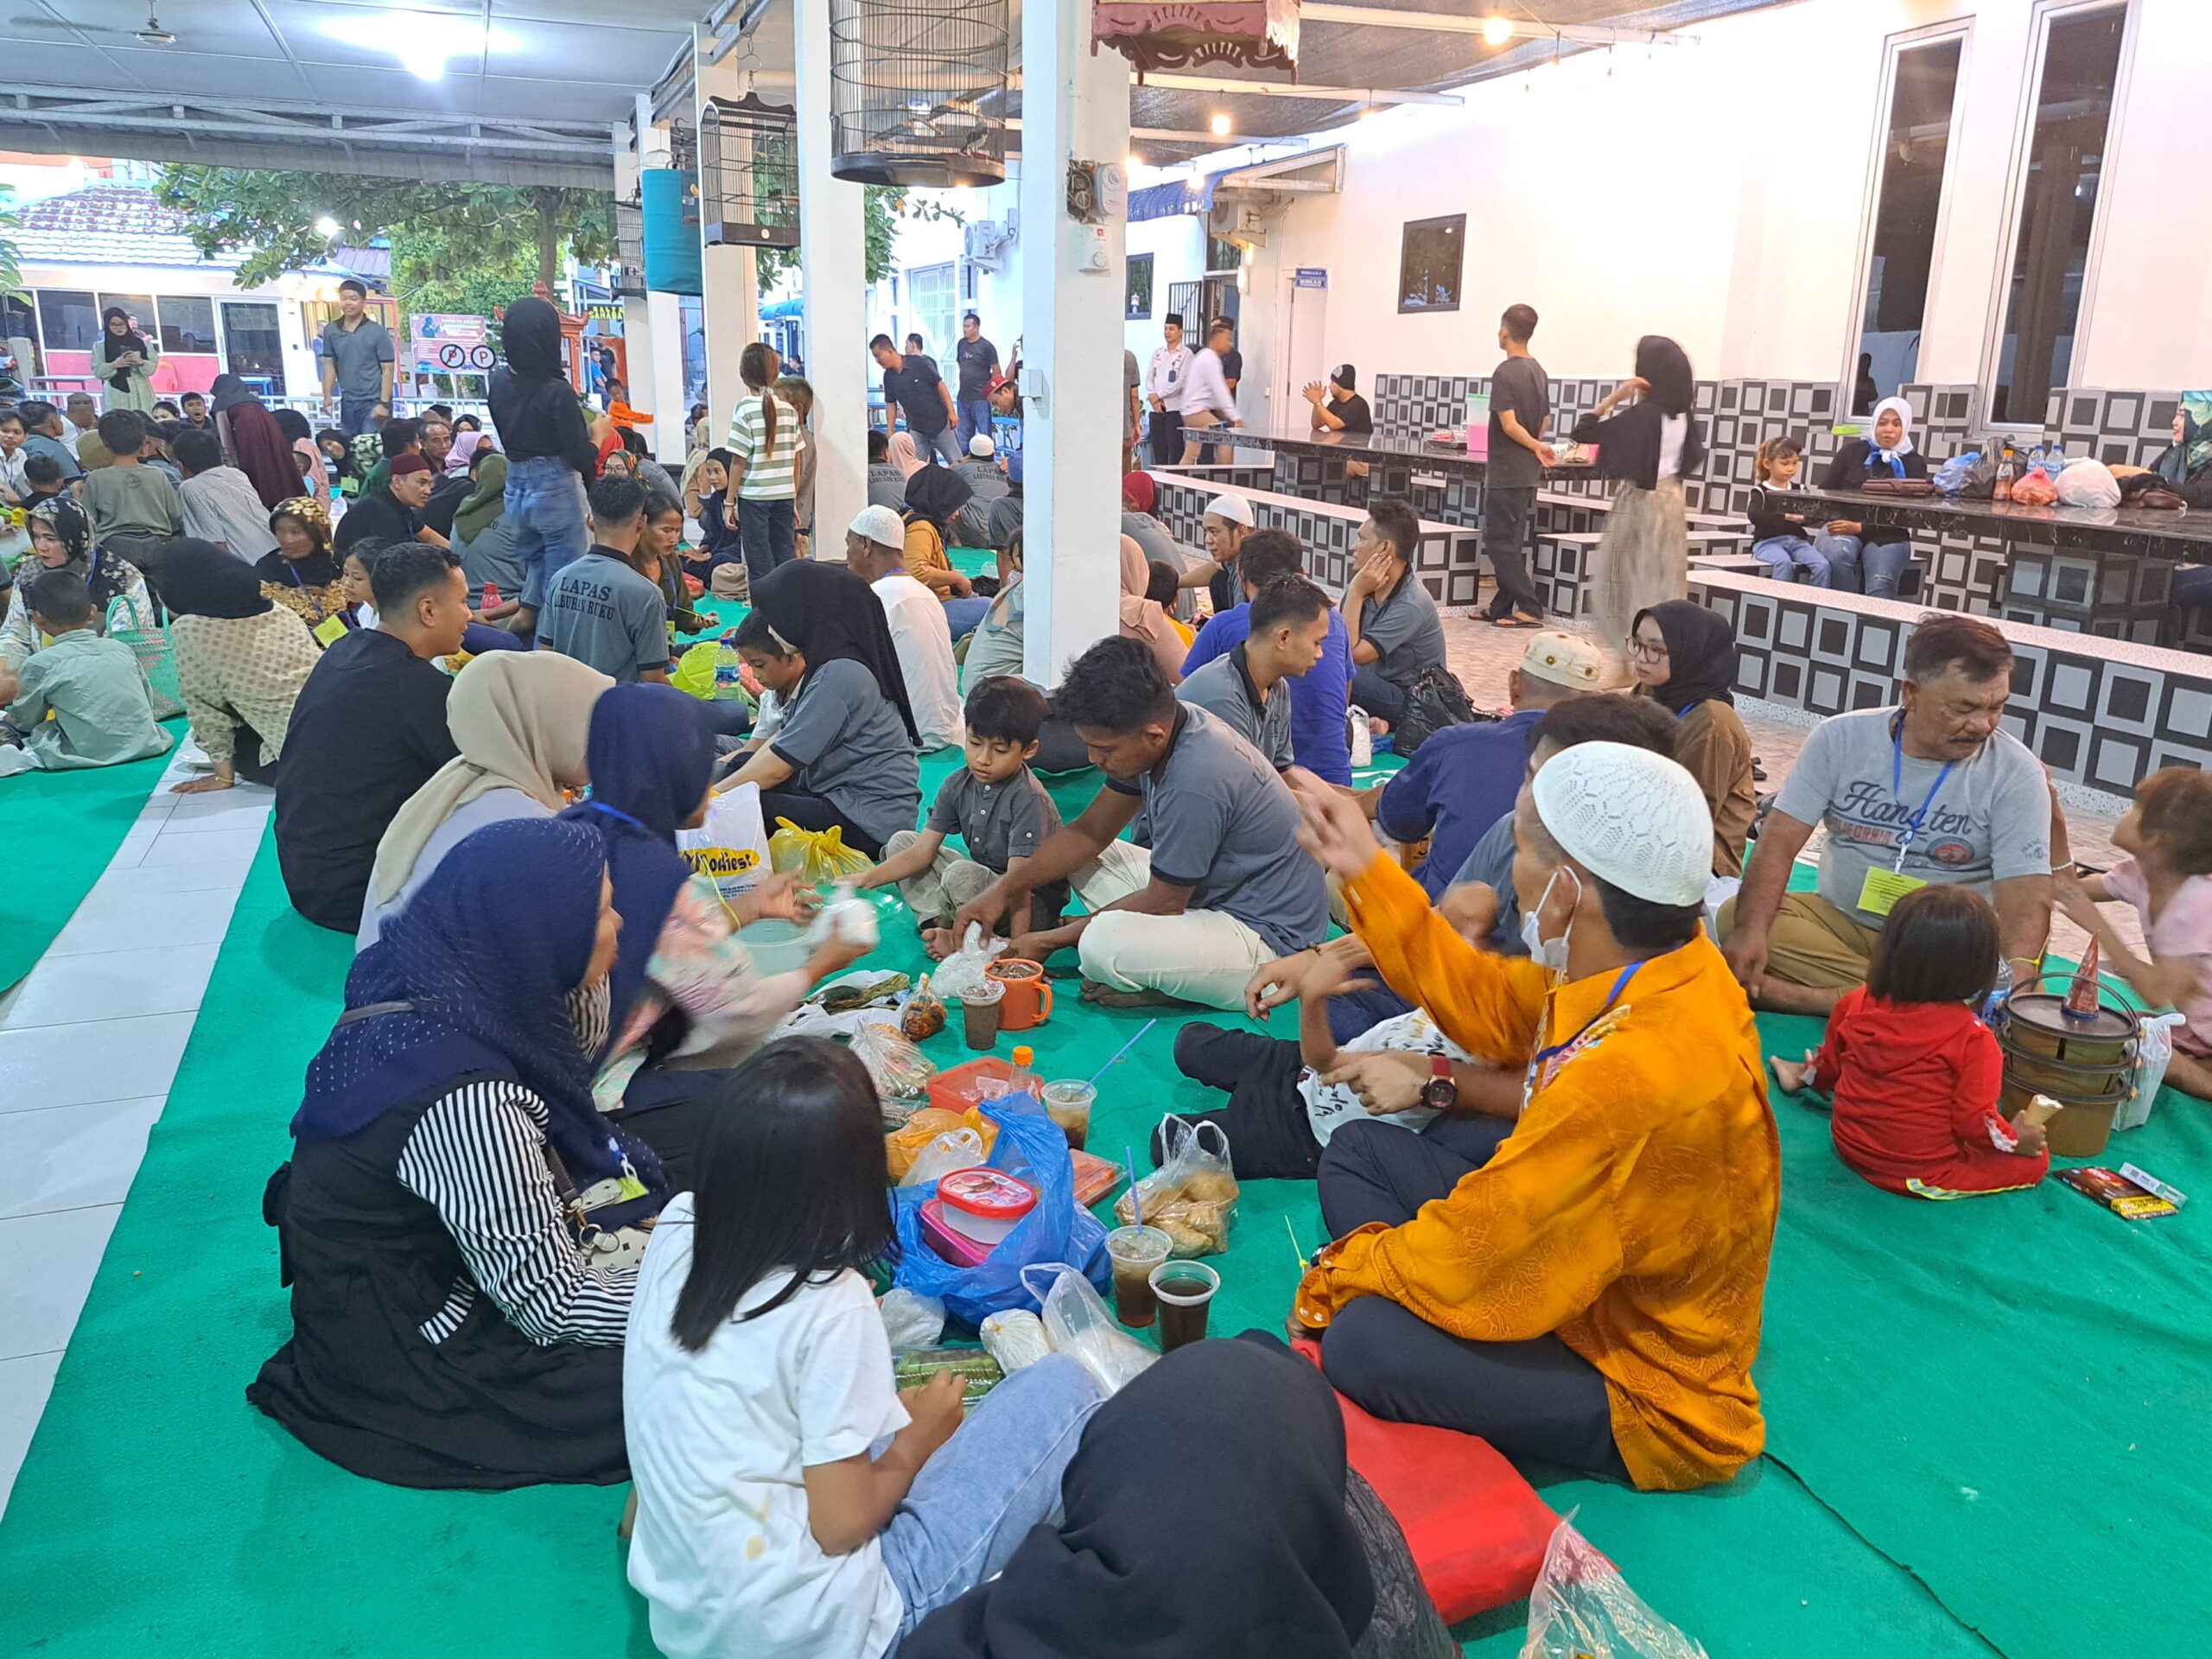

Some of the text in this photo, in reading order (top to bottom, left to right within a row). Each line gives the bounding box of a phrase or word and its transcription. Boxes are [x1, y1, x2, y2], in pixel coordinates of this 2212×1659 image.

[560, 576, 612, 601] LAPAS
[588, 600, 615, 620] RUKU
[1929, 804, 1972, 836] ten
